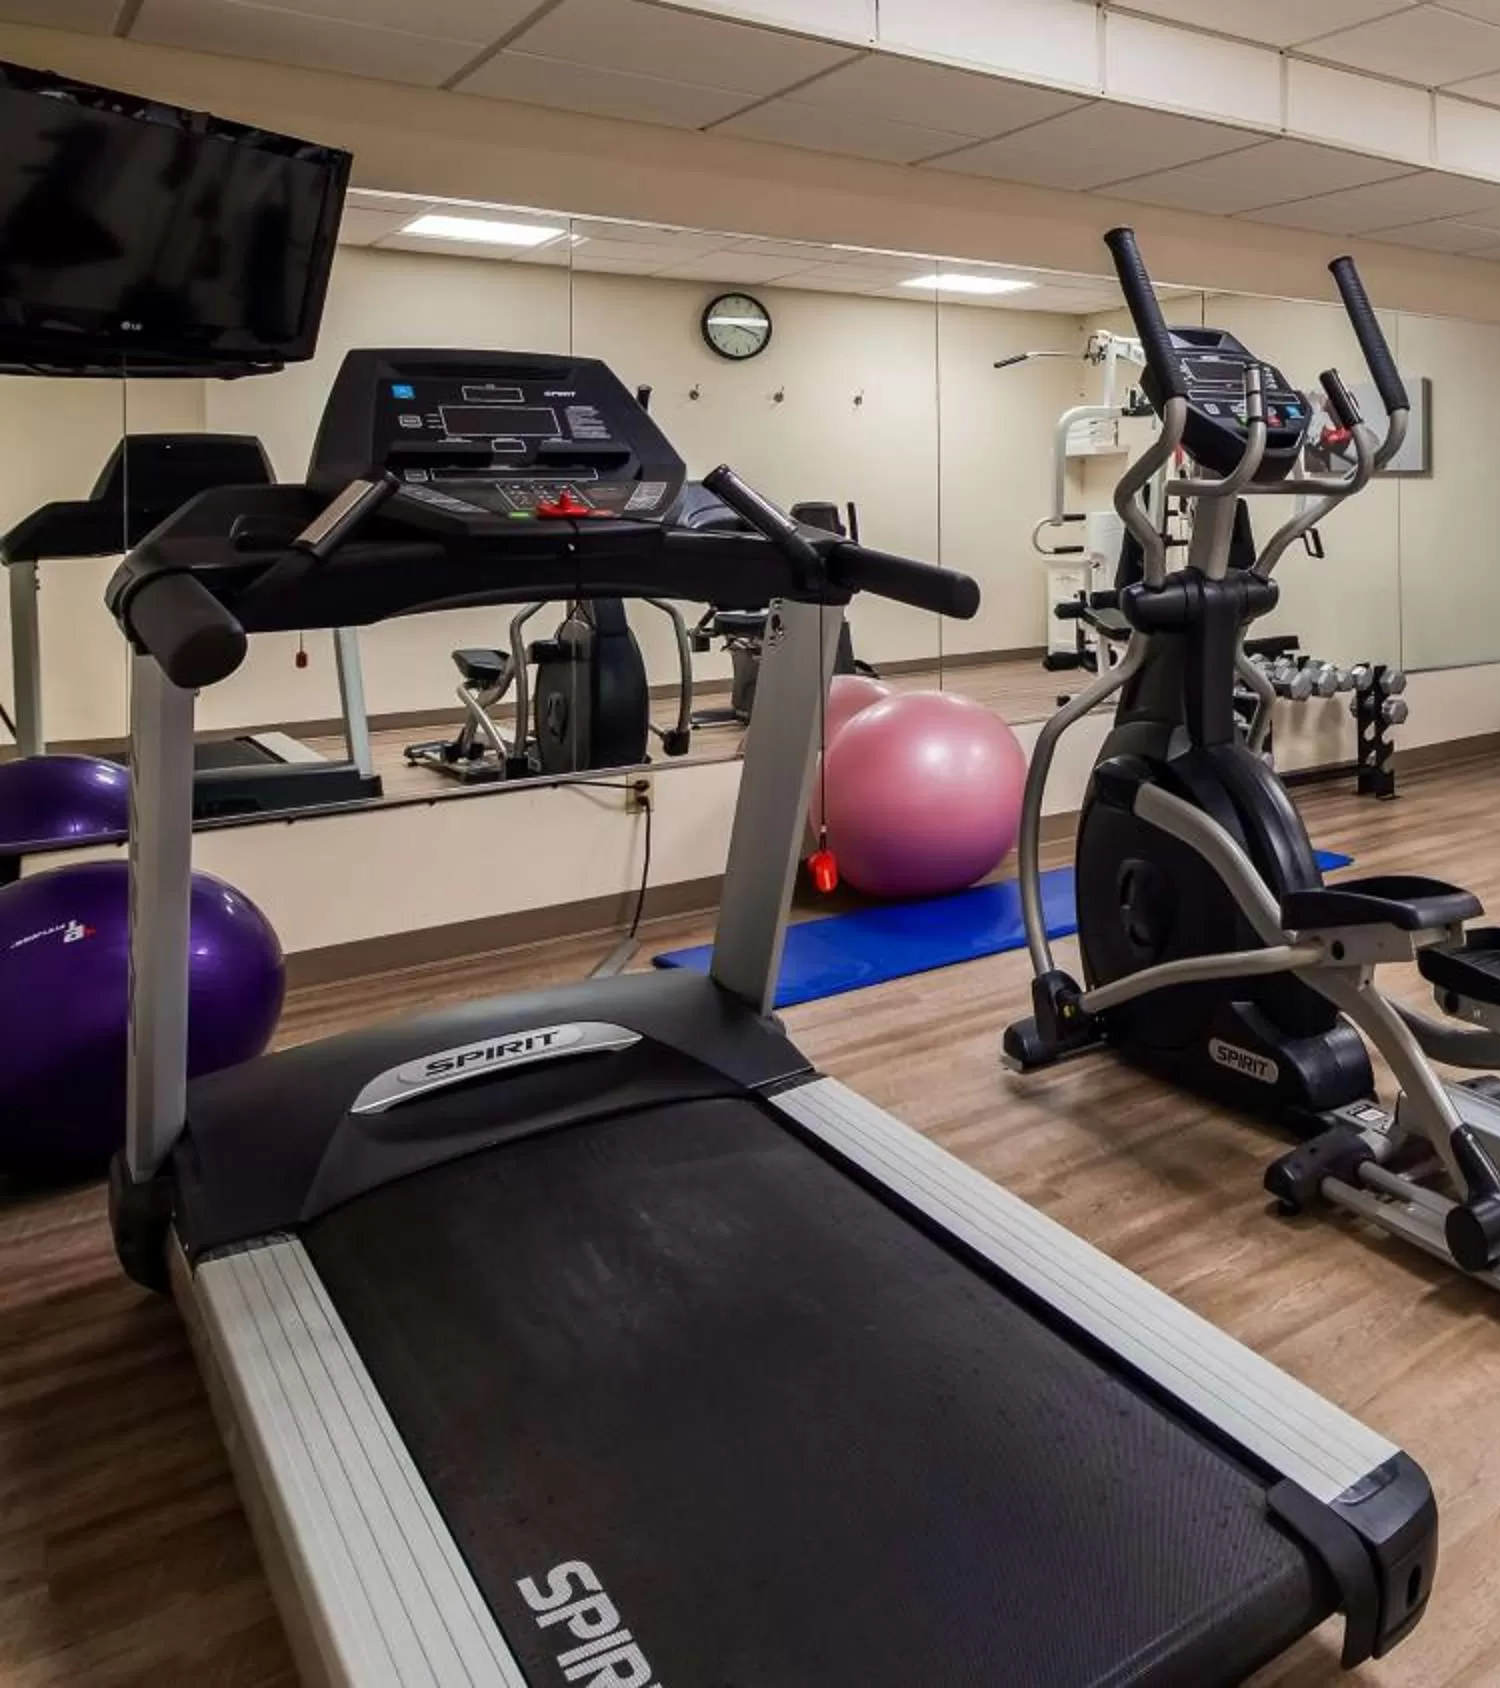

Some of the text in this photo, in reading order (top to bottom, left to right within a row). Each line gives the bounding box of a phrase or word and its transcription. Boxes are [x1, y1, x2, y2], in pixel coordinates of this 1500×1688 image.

[425, 1029, 561, 1077] SPIRIT
[1217, 1045, 1269, 1077] SPIRIT
[516, 1560, 665, 1688] SPIR
